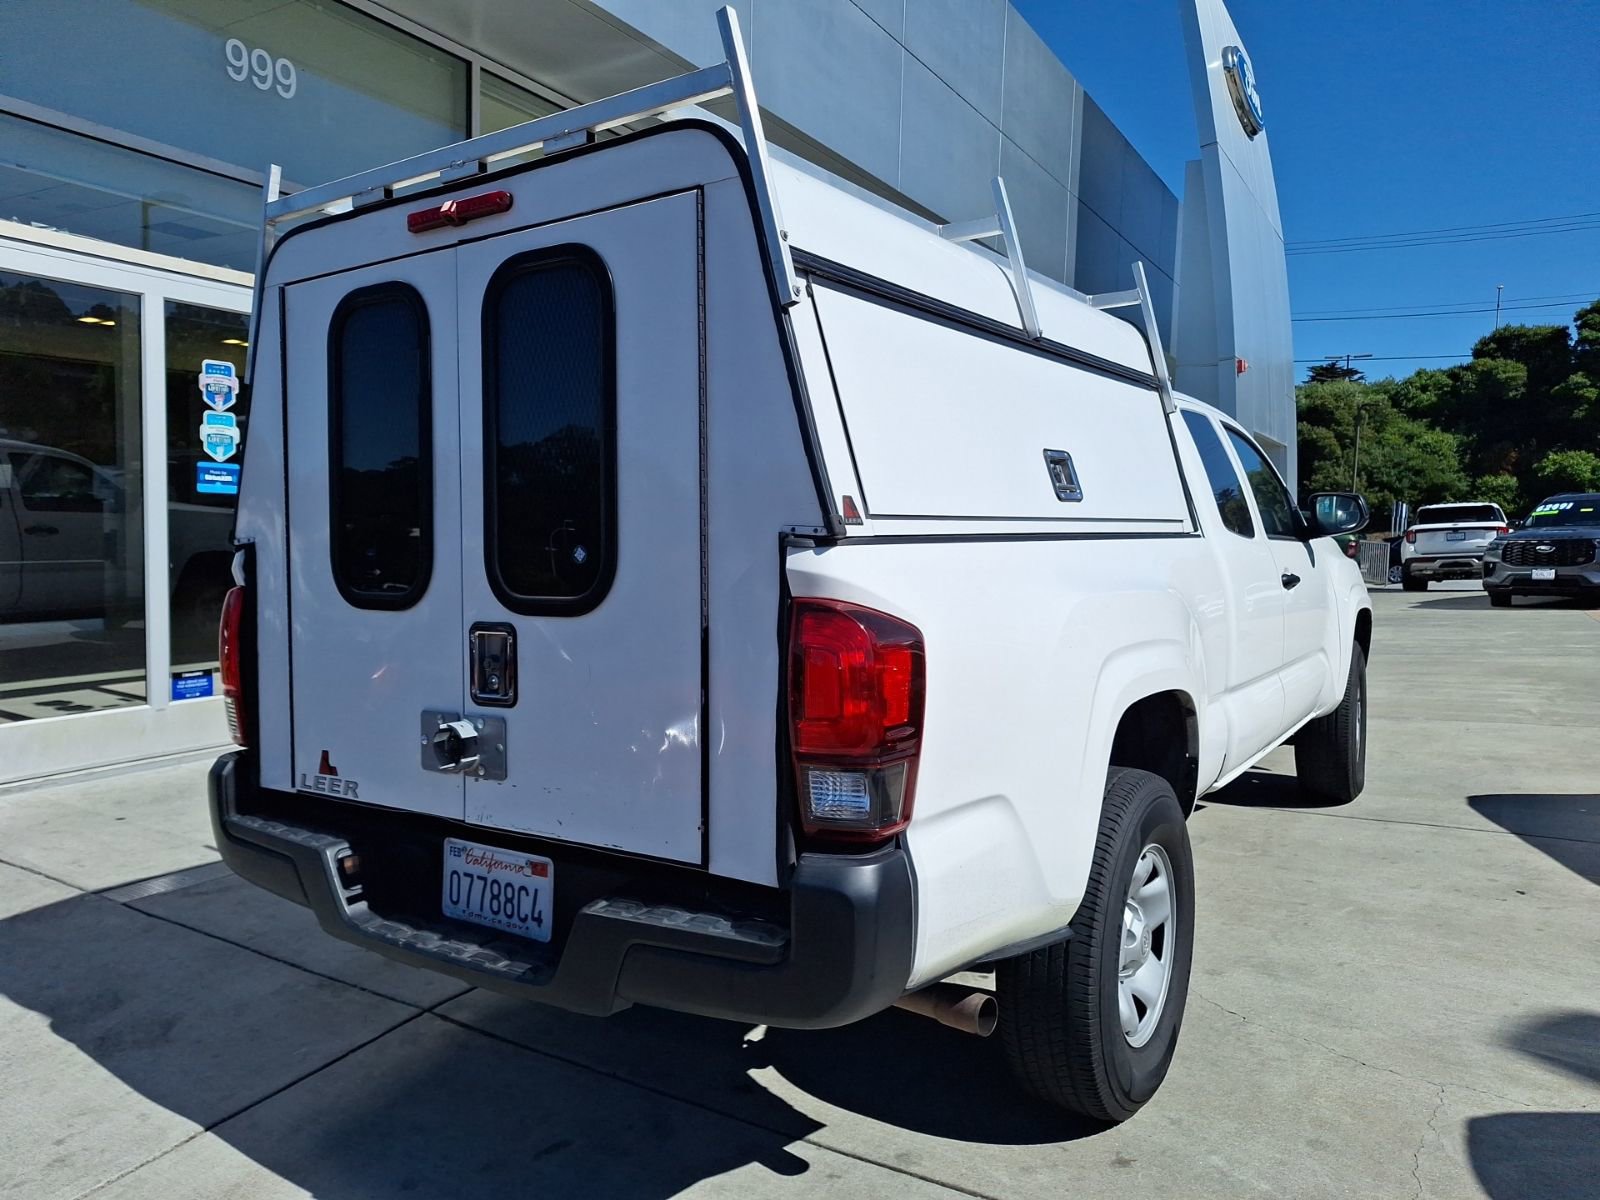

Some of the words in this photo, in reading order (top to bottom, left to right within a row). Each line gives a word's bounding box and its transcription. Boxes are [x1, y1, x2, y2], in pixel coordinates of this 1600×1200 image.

[225, 38, 297, 99] 999
[300, 773, 359, 799] LEER
[464, 847, 524, 874] California
[449, 870, 543, 928] 07788C4
